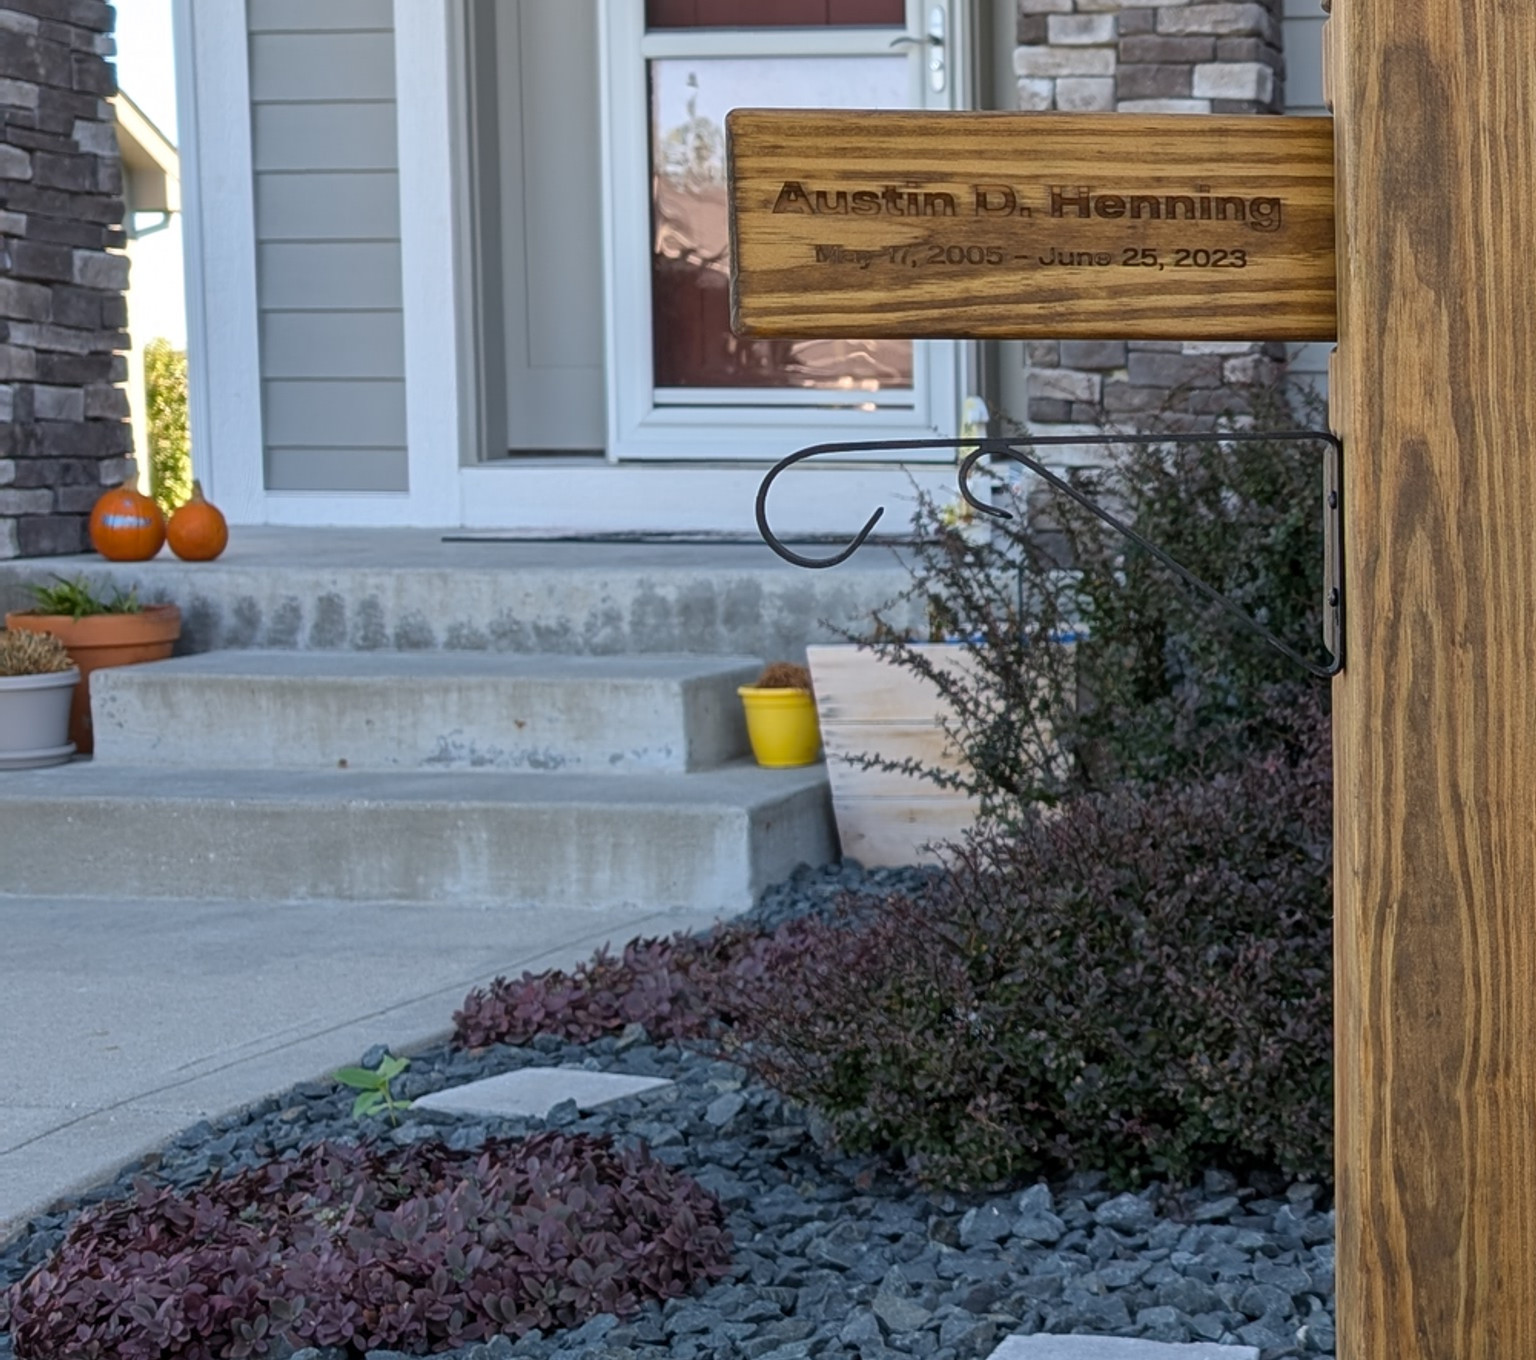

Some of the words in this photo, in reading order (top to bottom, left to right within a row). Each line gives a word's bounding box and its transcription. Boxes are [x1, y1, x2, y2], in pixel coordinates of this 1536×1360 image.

[772, 181, 956, 217] Austin
[972, 184, 1033, 218] D.
[1050, 184, 1281, 233] Henning
[814, 244, 874, 269] May
[926, 244, 1004, 265] 2005
[1038, 247, 1112, 267] June
[1122, 247, 1165, 271] 25,
[1174, 249, 1248, 268] 2023
